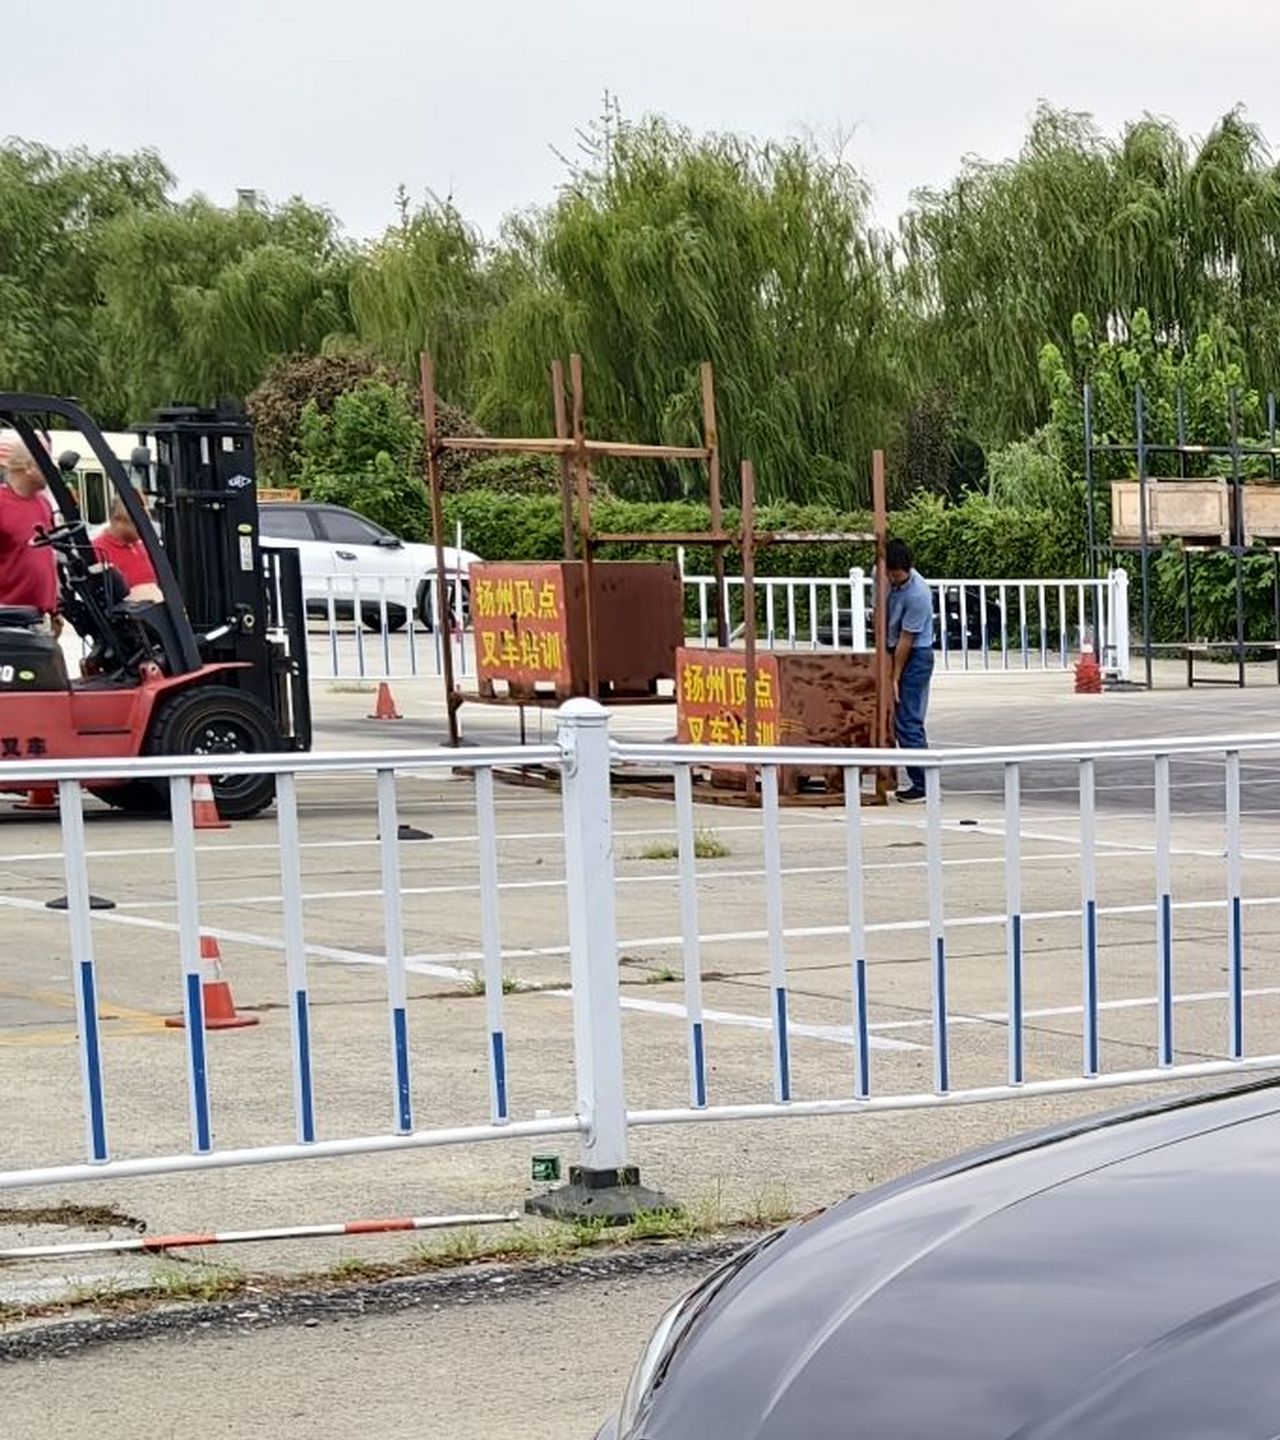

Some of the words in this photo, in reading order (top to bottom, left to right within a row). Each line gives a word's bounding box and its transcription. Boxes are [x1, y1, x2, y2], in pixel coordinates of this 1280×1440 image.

[475, 579, 559, 617] 扬州顶点
[481, 630, 562, 669] 叉车培训
